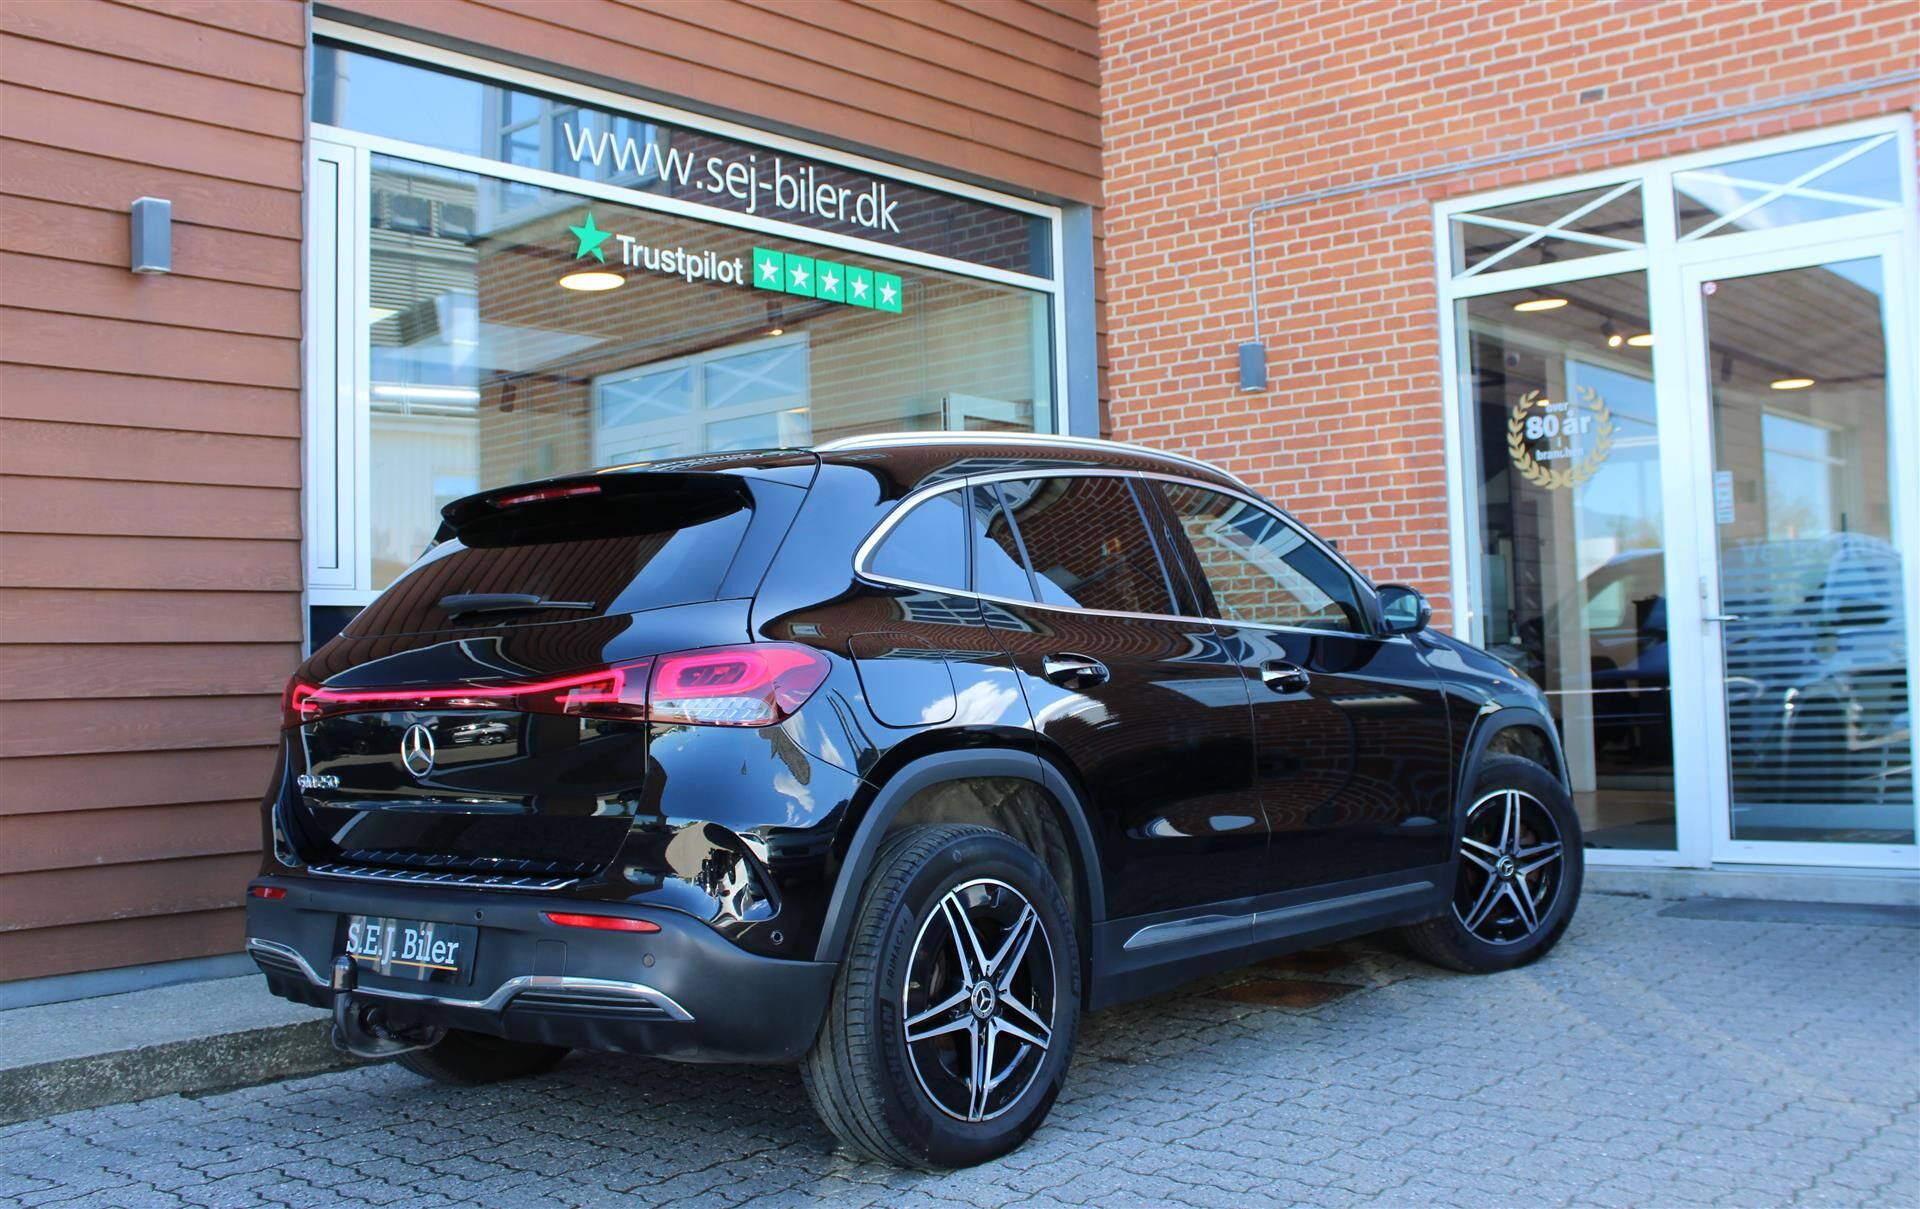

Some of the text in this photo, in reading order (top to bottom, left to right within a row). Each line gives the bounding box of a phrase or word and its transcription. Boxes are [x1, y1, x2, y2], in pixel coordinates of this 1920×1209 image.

[564, 121, 900, 233] www.sej-biler.dk
[616, 233, 744, 285] Trustpilot
[1526, 409, 1591, 440] 80 år
[346, 923, 459, 965] S.E.J. Biler
